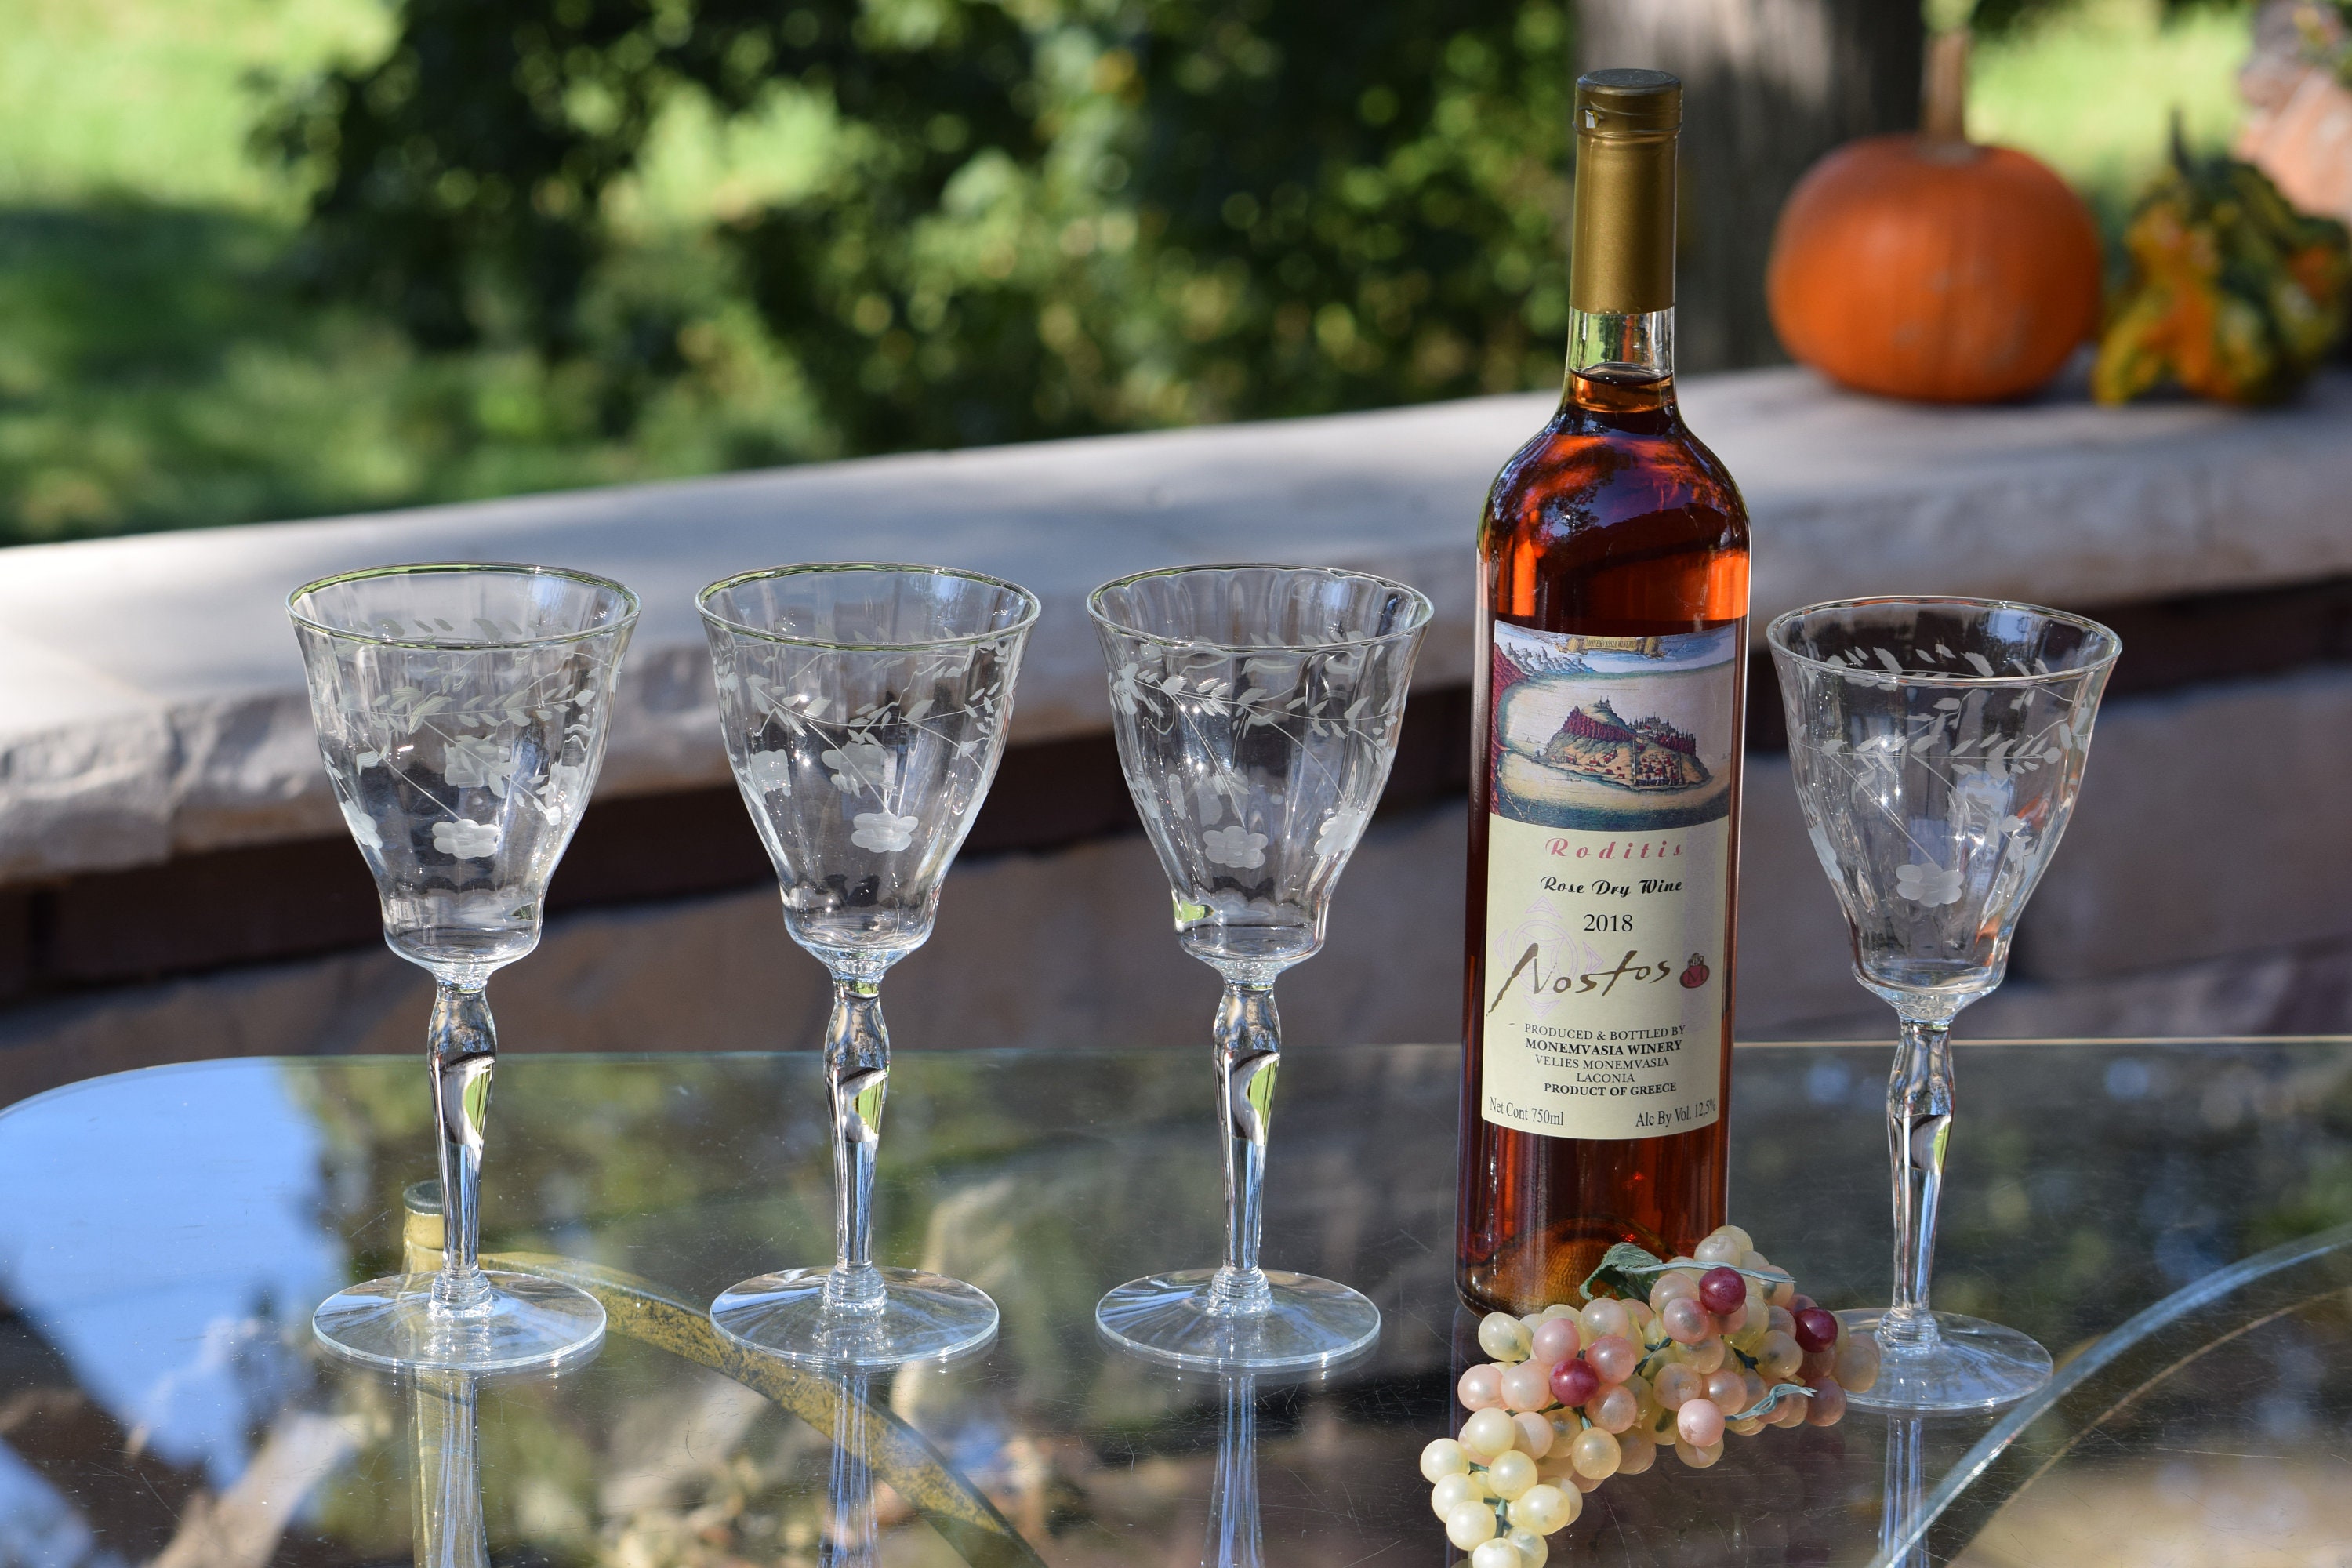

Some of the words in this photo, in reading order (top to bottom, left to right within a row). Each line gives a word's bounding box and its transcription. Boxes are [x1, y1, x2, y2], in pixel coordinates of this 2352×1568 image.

[1544, 837, 1683, 859] Roditis
[1540, 876, 1584, 894] Rose
[1591, 880, 1632, 898] Dry
[1637, 879, 1683, 895] Wine
[1583, 913, 1633, 932] 2018
[1486, 942, 1671, 1016] Nostos
[1524, 1023, 1593, 1040] PRODUCED
[1596, 1031, 1606, 1040] &
[1610, 1028, 1668, 1040] BOTTLED
[1671, 1025, 1686, 1036] BY
[1525, 1038, 1624, 1055] MONEMVASIA
[1627, 1040, 1682, 1055] WINERY
[1535, 1054, 1579, 1069] VELIES
[1583, 1057, 1669, 1069] MONEMVASIA
[1576, 1073, 1635, 1083] LACONIA
[1544, 1083, 1606, 1096] PRODUCT
[1610, 1087, 1628, 1096] OF
[1630, 1082, 1677, 1095] GREECE
[1490, 1096, 1504, 1114] Net
[1506, 1102, 1528, 1120] Cont
[1531, 1108, 1564, 1126] 750ml
[1635, 1112, 1654, 1127] Alc
[1657, 1110, 1672, 1128] By
[1675, 1105, 1692, 1122] Vol.
[1695, 1098, 1716, 1118] 12,5%
